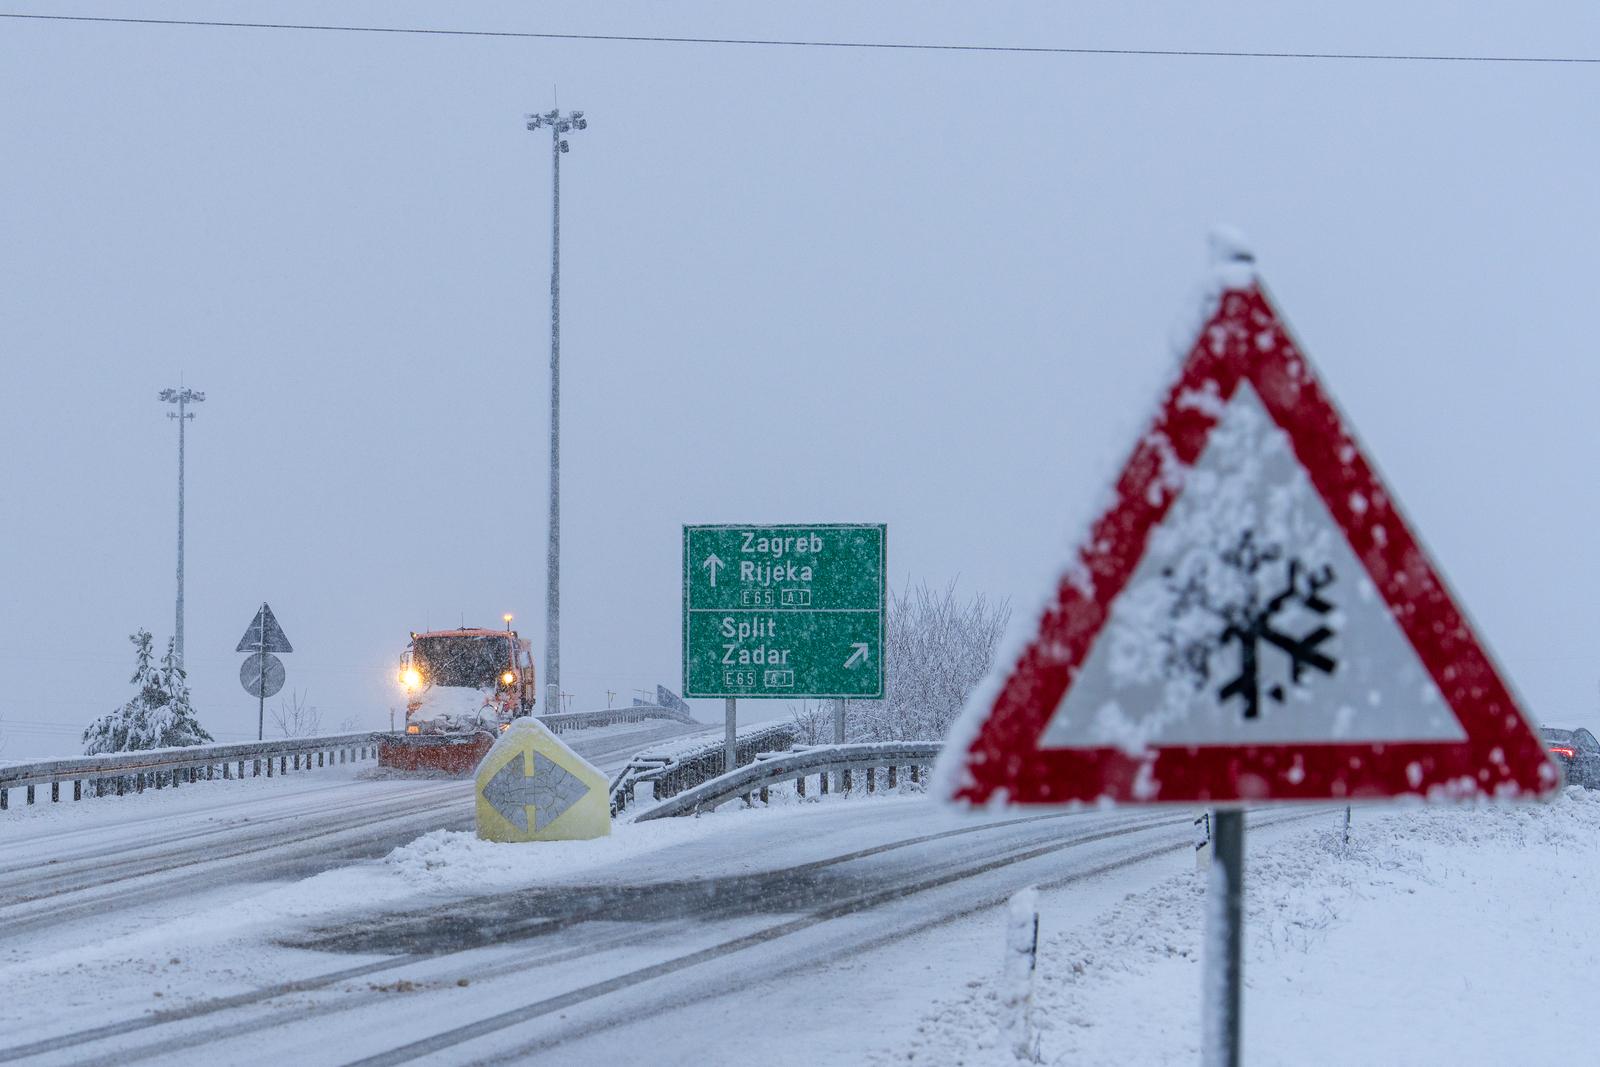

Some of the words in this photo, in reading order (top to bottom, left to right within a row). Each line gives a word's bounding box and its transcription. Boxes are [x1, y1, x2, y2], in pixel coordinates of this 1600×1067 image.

[741, 532, 823, 558] Zagreb
[740, 561, 813, 586] Rijeka
[722, 617, 776, 642] Split
[721, 644, 790, 665] Zadar
